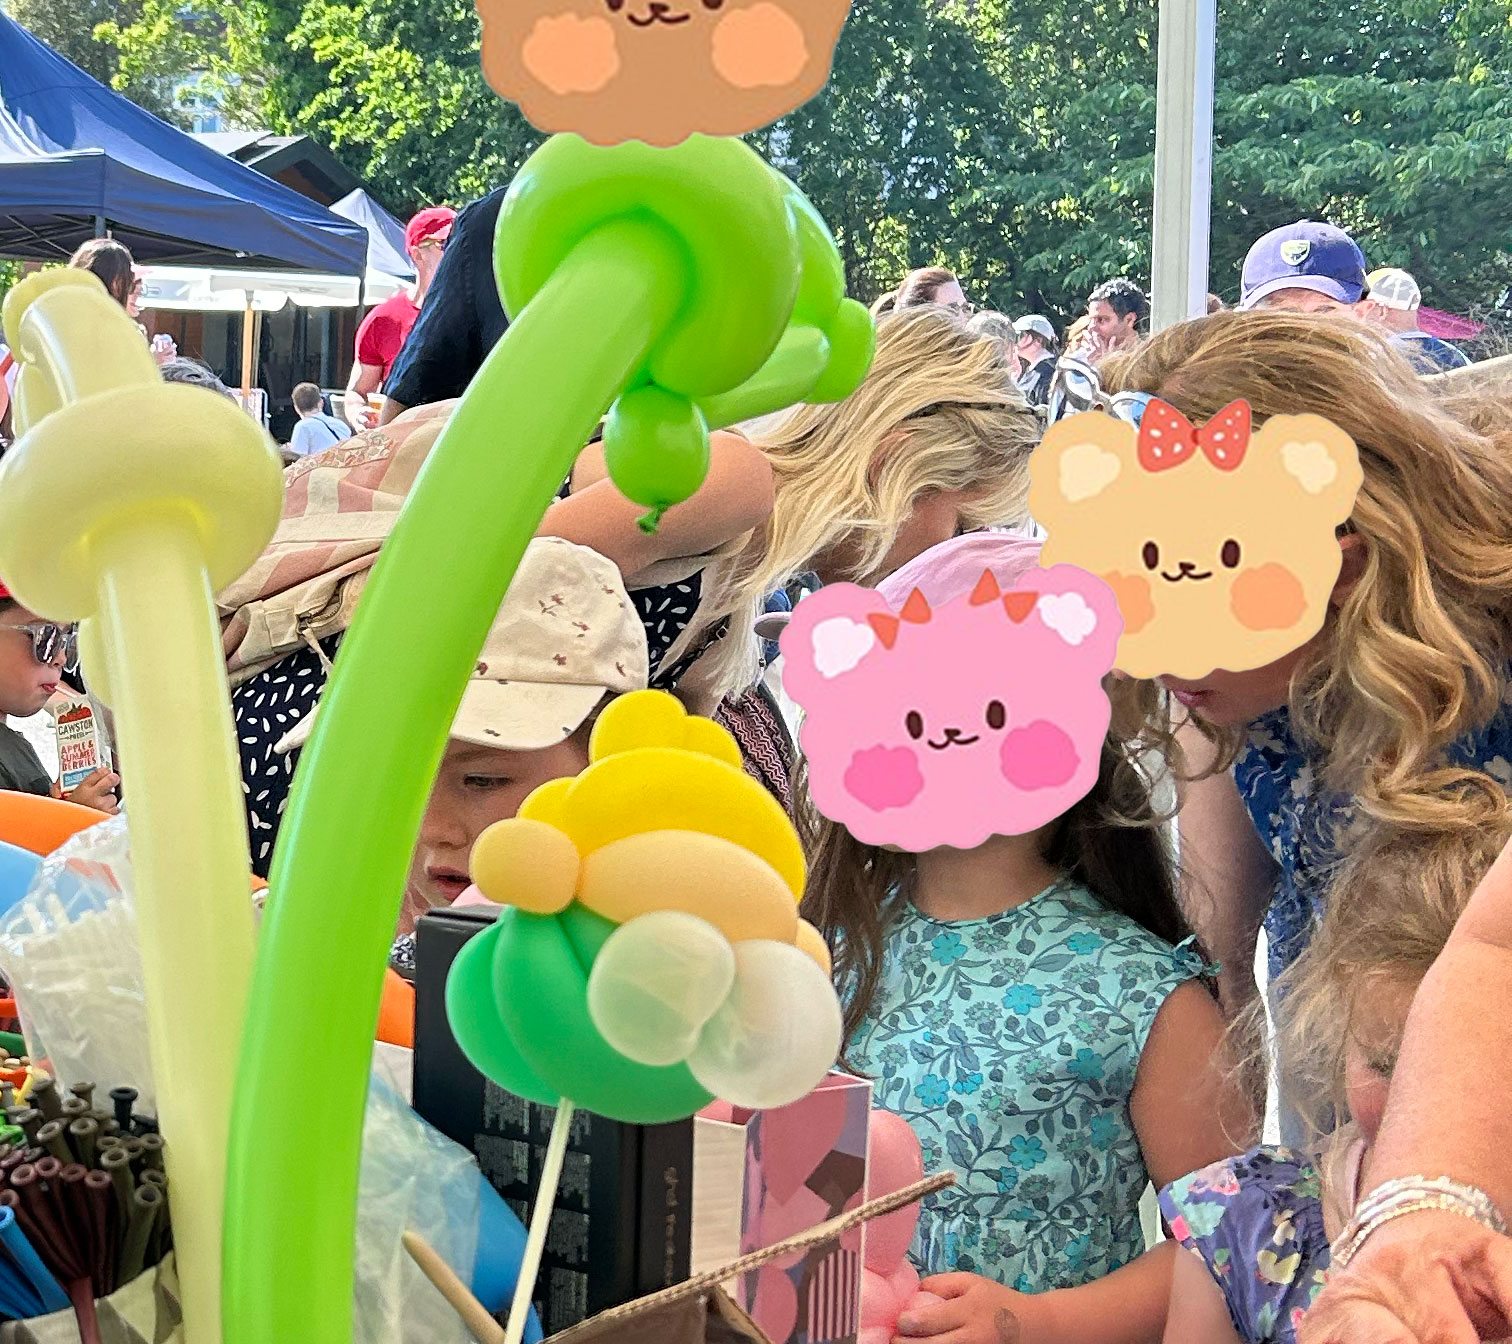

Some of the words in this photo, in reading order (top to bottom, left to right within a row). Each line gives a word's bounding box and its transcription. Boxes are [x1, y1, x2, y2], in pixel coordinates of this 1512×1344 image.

[58, 718, 94, 735] CAWSTON
[61, 741, 85, 754] APPLE
[87, 739, 94, 749] &
[61, 749, 95, 762] SUMMER
[62, 758, 96, 772] BERRIES
